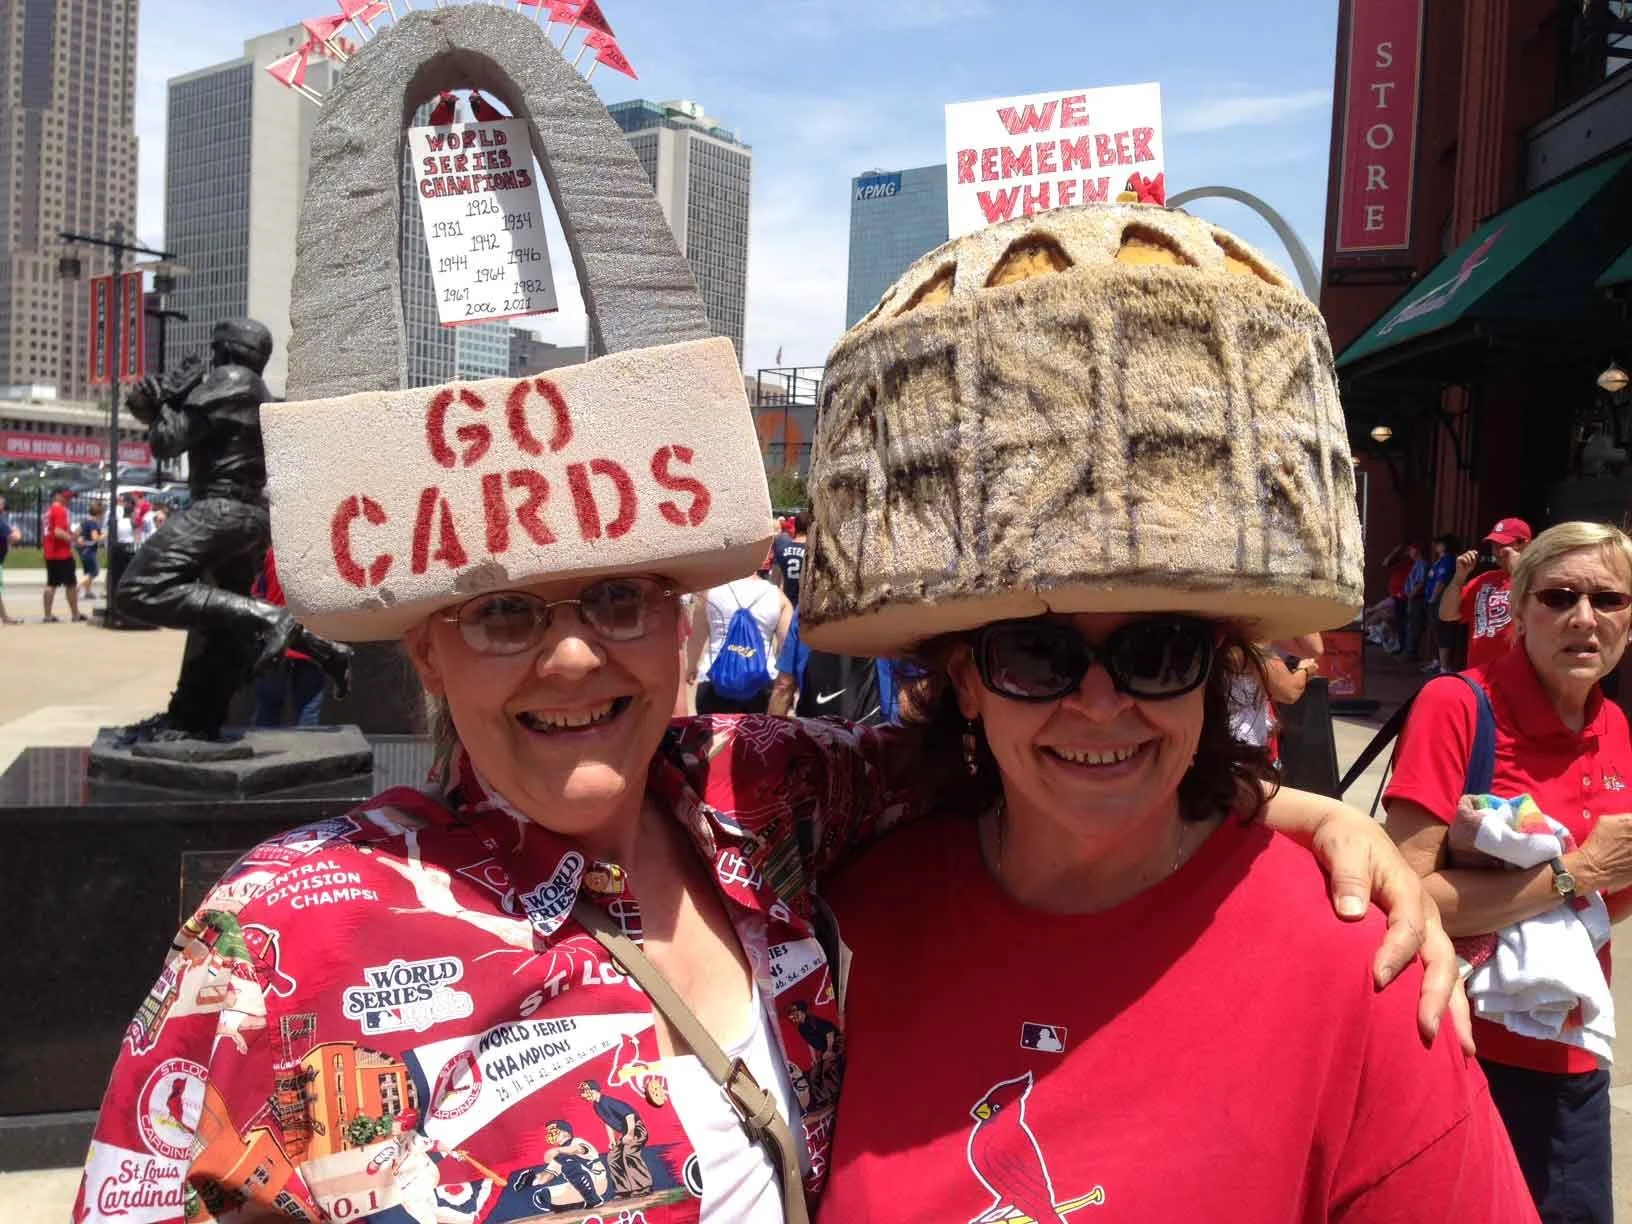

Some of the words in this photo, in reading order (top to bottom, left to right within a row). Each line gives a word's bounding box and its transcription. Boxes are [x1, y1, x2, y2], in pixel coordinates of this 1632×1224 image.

[996, 94, 1090, 136] WE
[425, 129, 508, 152] WORLD
[1363, 41, 1395, 231] STORE
[423, 150, 513, 176] SERIES
[957, 127, 1156, 184] REMEMBER
[419, 168, 533, 199] CHAMPIONS
[855, 182, 897, 200] KPMG
[465, 200, 500, 217] 1926
[976, 176, 1111, 224] WHEN
[432, 221, 464, 238] 1931
[501, 212, 533, 232] 1934
[469, 233, 500, 252] 1942
[438, 255, 468, 272] 1944
[507, 249, 542, 265] 1946
[473, 266, 505, 283] 1964
[443, 288, 470, 302] 1967
[512, 279, 545, 294] 1982
[464, 302, 497, 316] 2006
[503, 298, 532, 312] 2011
[425, 377, 575, 469] GO
[330, 444, 713, 588] CARDS
[266, 872, 361, 906] DIVISION
[291, 888, 379, 910] CHAMPS!
[526, 856, 579, 911] WORLD
[529, 886, 577, 924] ERIES
[371, 962, 458, 988] WORLD
[349, 982, 434, 1013] SERIES
[520, 969, 569, 1017] ST.
[480, 1024, 530, 1053] WORLD
[533, 1018, 577, 1037] SERIES
[181, 1063, 208, 1081] LOU
[485, 1039, 571, 1082] CHAMPIONS
[141, 1115, 193, 1160] CARDINA
[118, 1159, 142, 1184] St.
[138, 1159, 180, 1185] Louis
[98, 1176, 185, 1217] Cardinal
